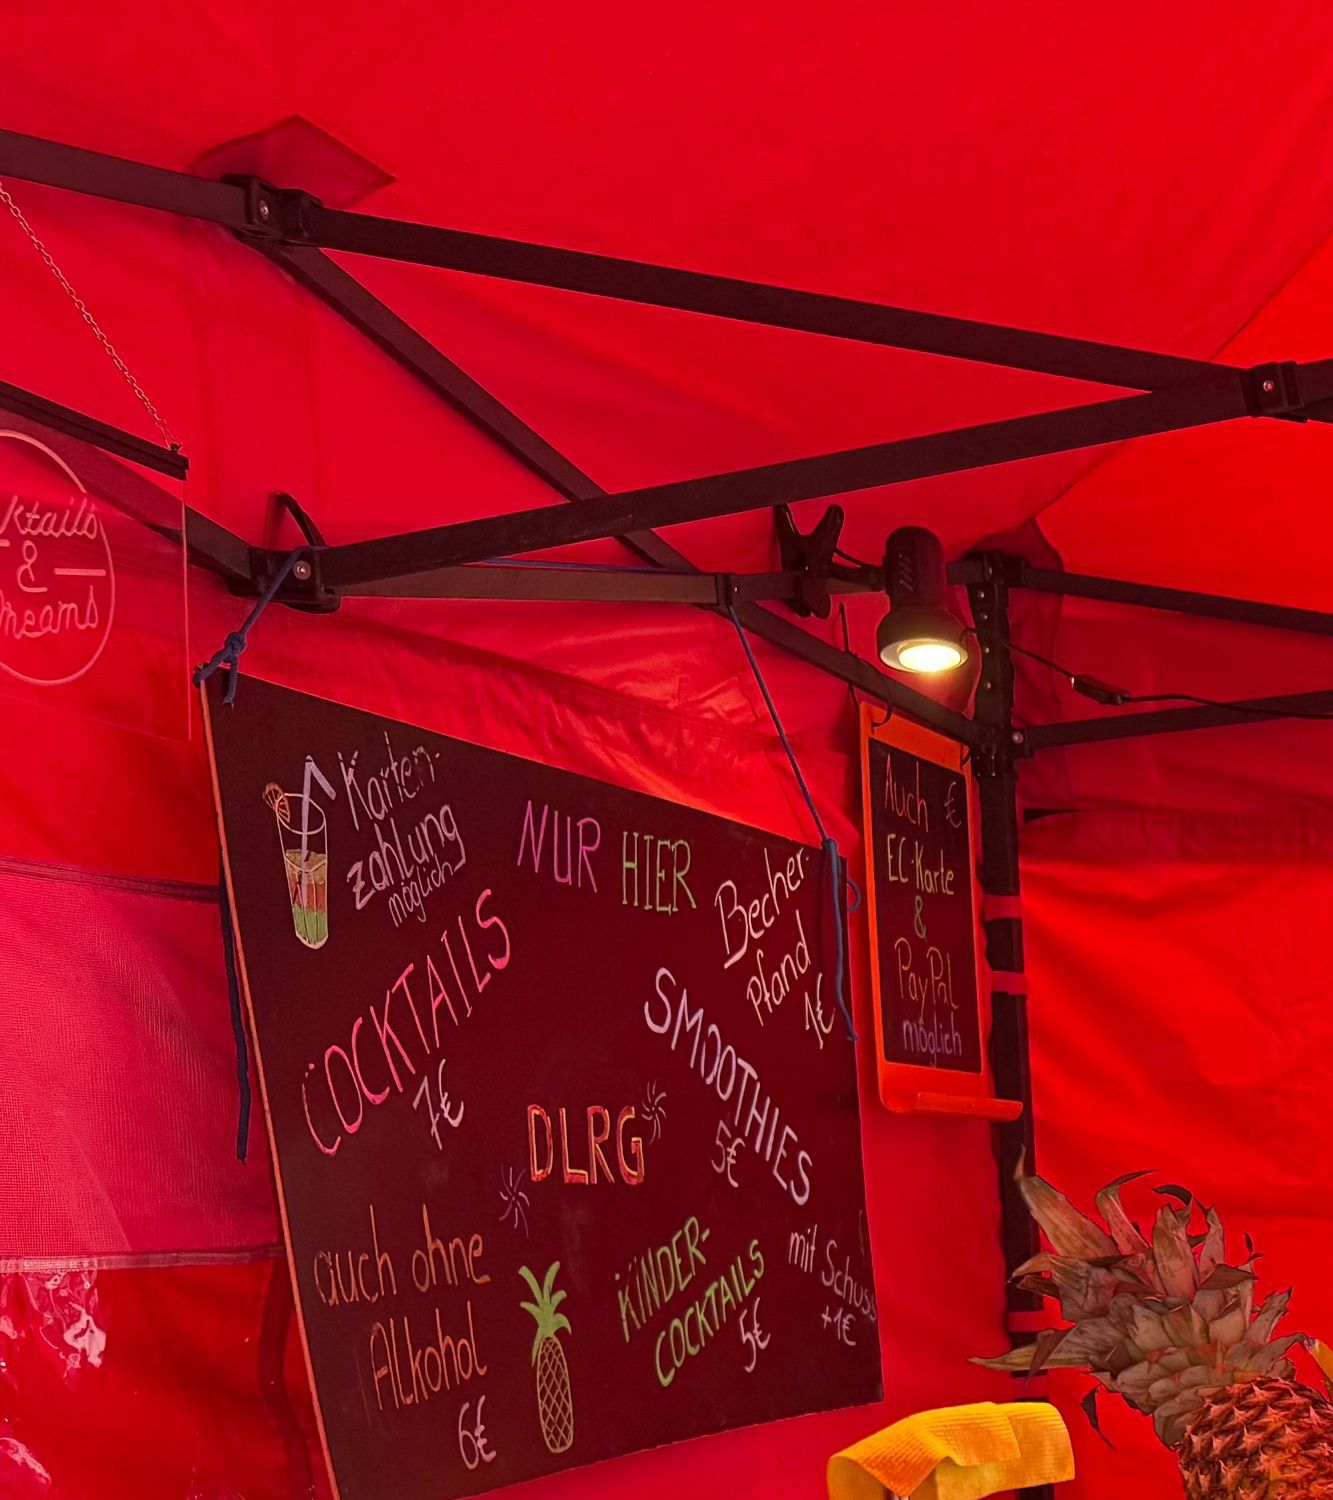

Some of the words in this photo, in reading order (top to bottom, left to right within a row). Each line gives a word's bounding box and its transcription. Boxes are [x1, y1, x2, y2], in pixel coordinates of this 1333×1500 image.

[0, 585, 98, 640] reams
[884, 753, 930, 833] Auch
[347, 804, 466, 911] zahlung
[516, 800, 601, 893] NUR
[620, 830, 697, 915] HIER
[913, 895, 927, 943] &
[804, 972, 836, 1050] 1€
[894, 936, 961, 1021] PayPal
[302, 889, 512, 1157] COCKTAILS
[902, 1011, 963, 1070] möglich
[412, 1058, 465, 1151] 7€
[643, 966, 813, 1206] SMOOTHIES
[527, 1104, 646, 1186] DLRG
[711, 1119, 746, 1188] 5€
[313, 1204, 397, 1306] auch
[411, 1203, 491, 1294] ohne
[788, 1223, 817, 1275] mit
[821, 1238, 878, 1323] Schuss
[655, 1238, 765, 1388] COCKTAILS
[739, 1296, 771, 1374] 5€
[370, 1301, 488, 1411] Alkohol
[457, 1395, 498, 1471] 6€
